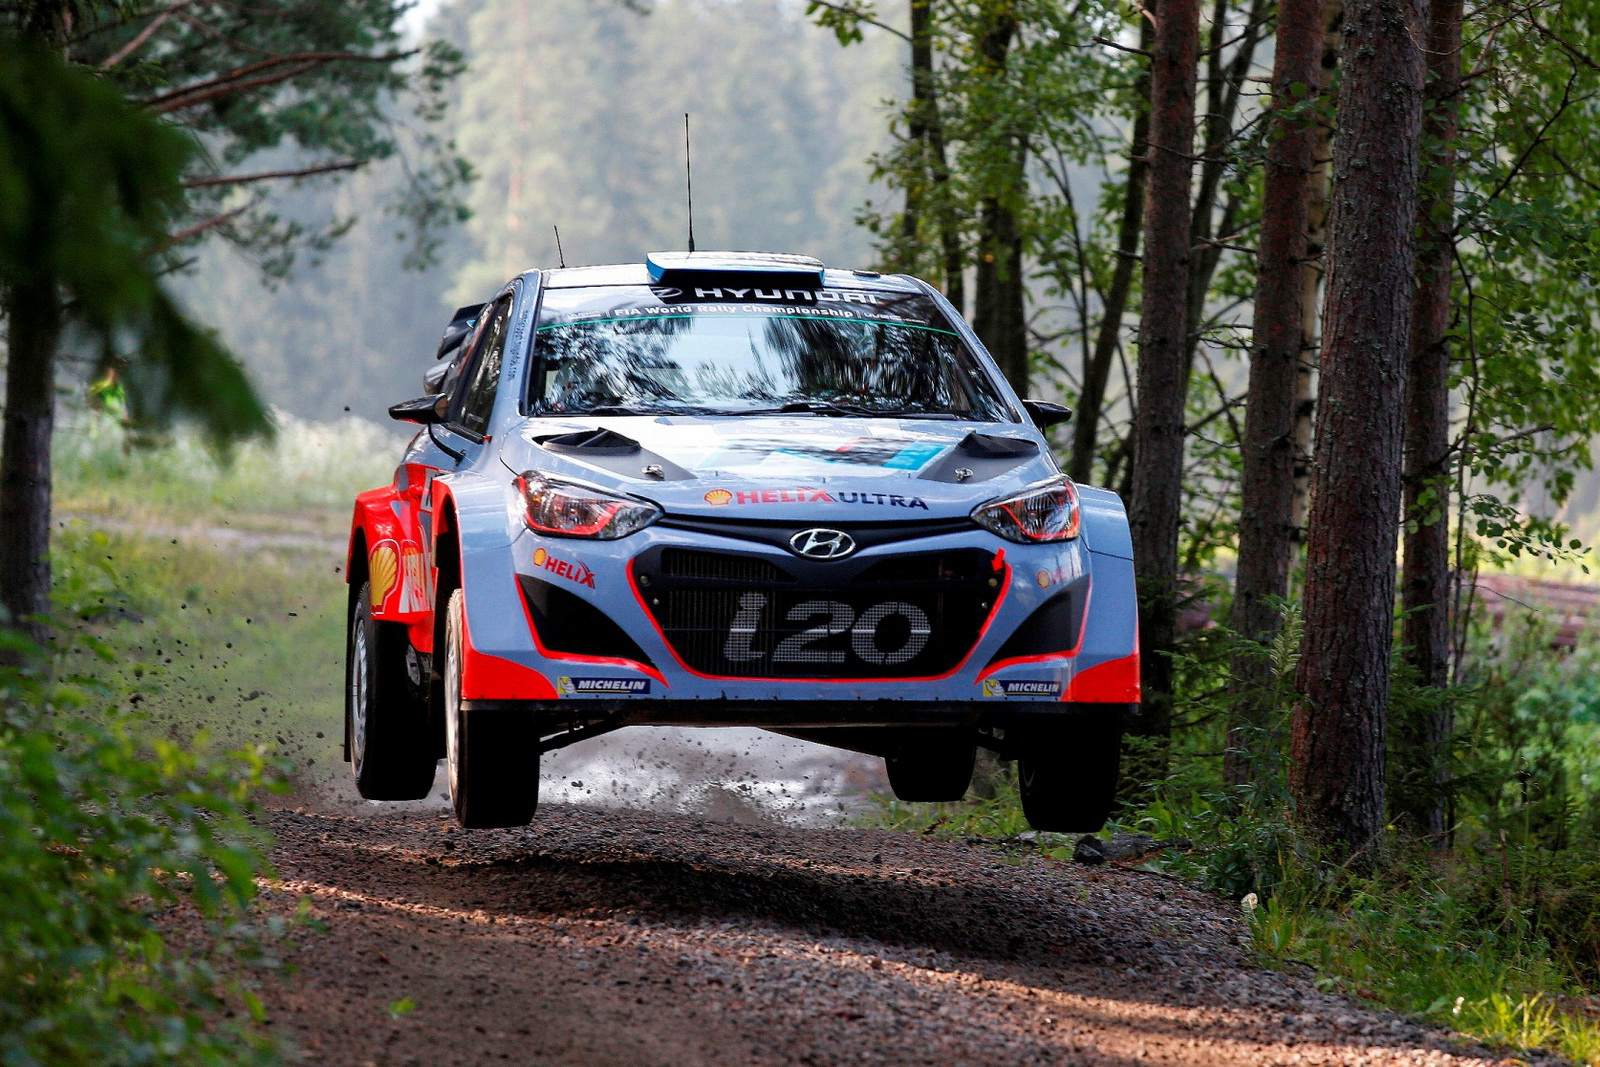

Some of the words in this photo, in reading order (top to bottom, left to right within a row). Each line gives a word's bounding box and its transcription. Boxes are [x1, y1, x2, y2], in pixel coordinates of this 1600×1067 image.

[694, 287, 878, 305] HYUNDAI
[614, 308, 642, 317] FIA
[645, 305, 693, 315] World
[697, 304, 737, 314] Rally
[742, 305, 854, 318] Championship
[736, 486, 837, 505] HELIX
[838, 491, 930, 511] ULTRA
[544, 555, 596, 590] HELIX
[577, 679, 646, 691] MICHELIN
[1007, 682, 1060, 693] MICHELIN
